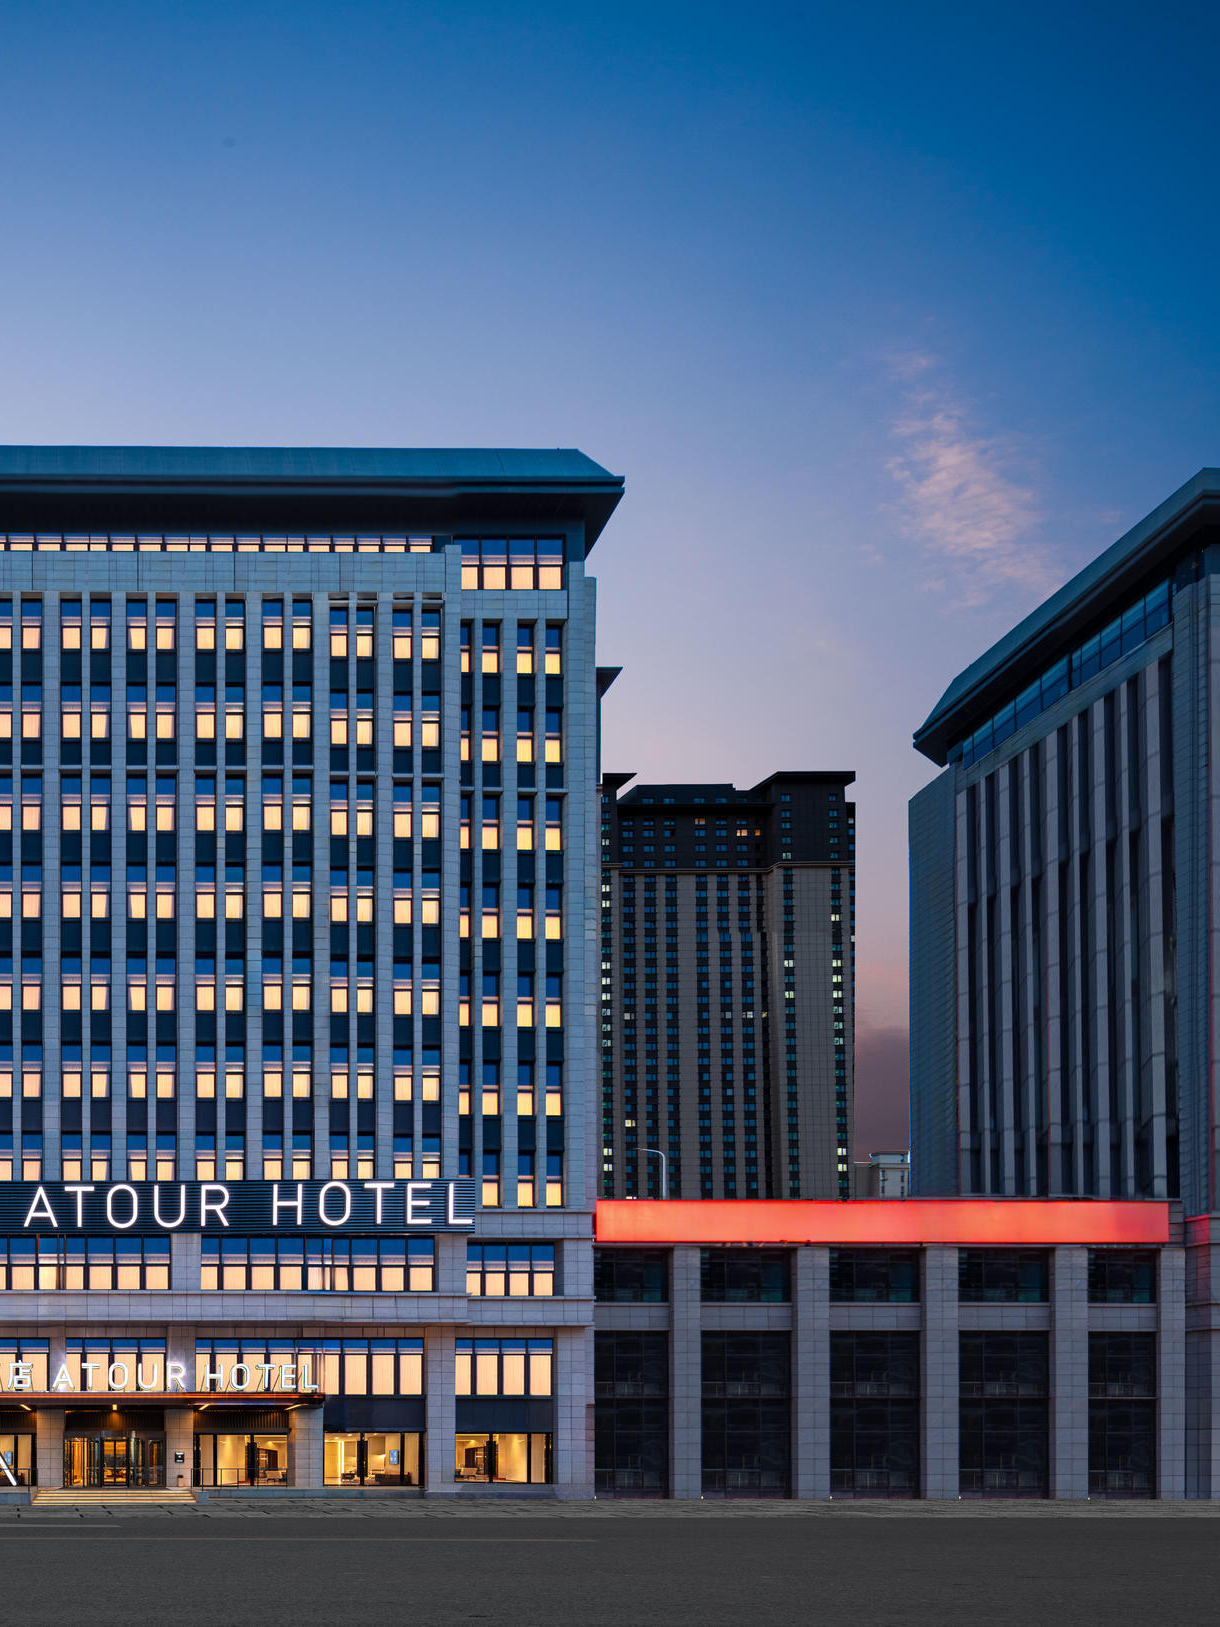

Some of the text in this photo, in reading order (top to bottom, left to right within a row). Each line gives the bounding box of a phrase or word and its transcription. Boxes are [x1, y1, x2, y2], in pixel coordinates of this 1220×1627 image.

[23, 1182, 473, 1228] ATOUR HOTEL
[51, 1363, 319, 1390] ATOUR HOTEL
